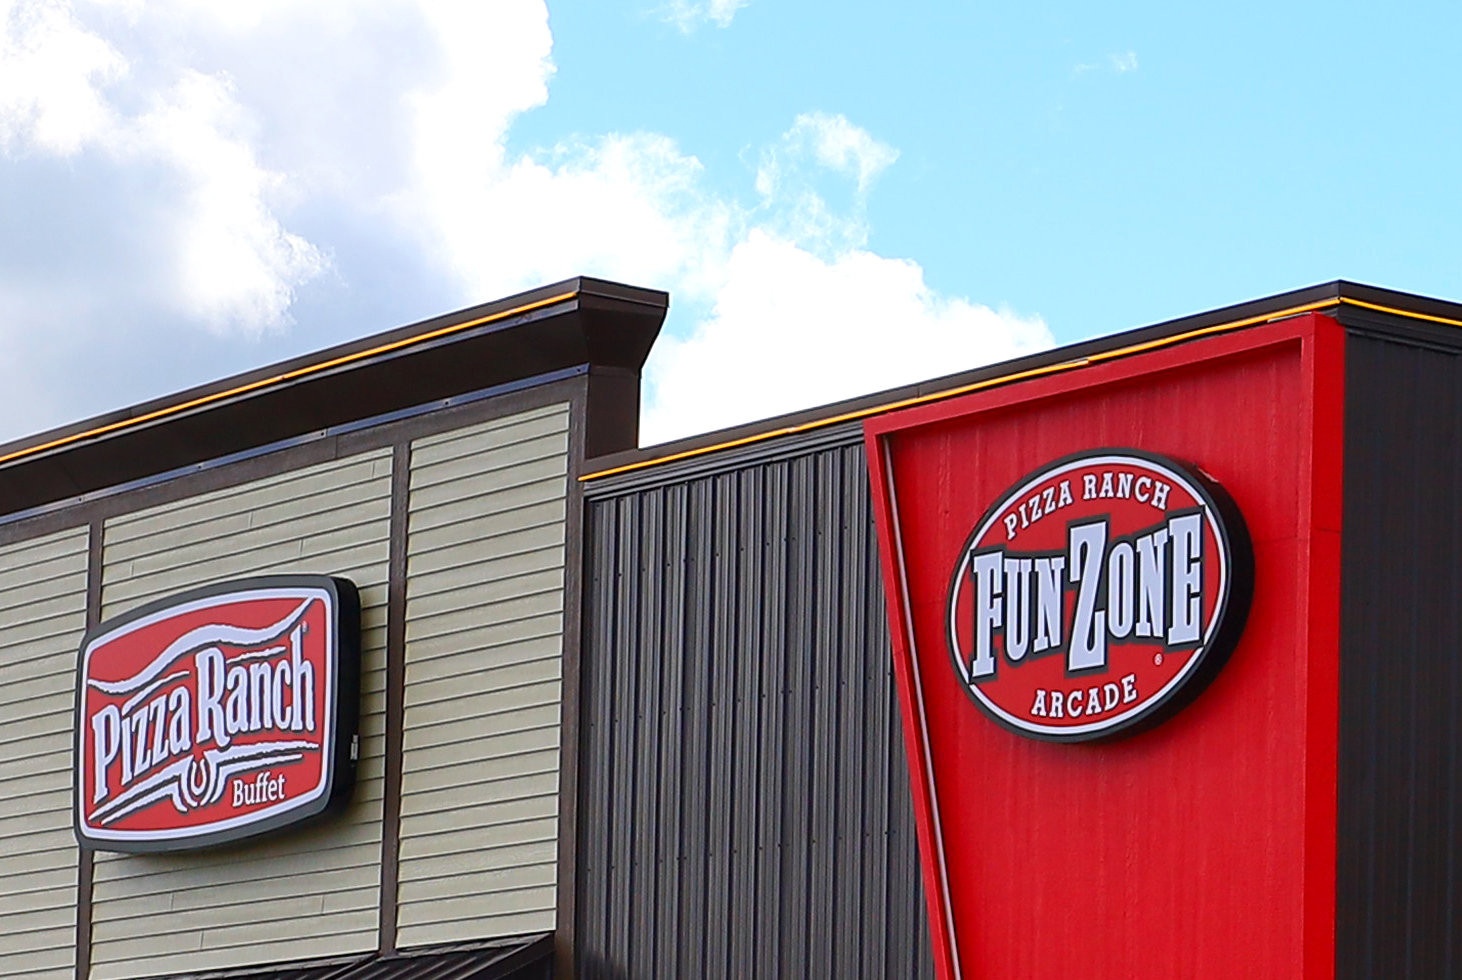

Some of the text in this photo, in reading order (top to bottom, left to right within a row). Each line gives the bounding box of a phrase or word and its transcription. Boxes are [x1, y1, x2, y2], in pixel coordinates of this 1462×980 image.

[1003, 472, 1171, 540] PIZZA RANCH
[92, 623, 315, 804] Pizza Ranch
[1031, 674, 1138, 718] ARCADE
[232, 774, 286, 808] Buffet
